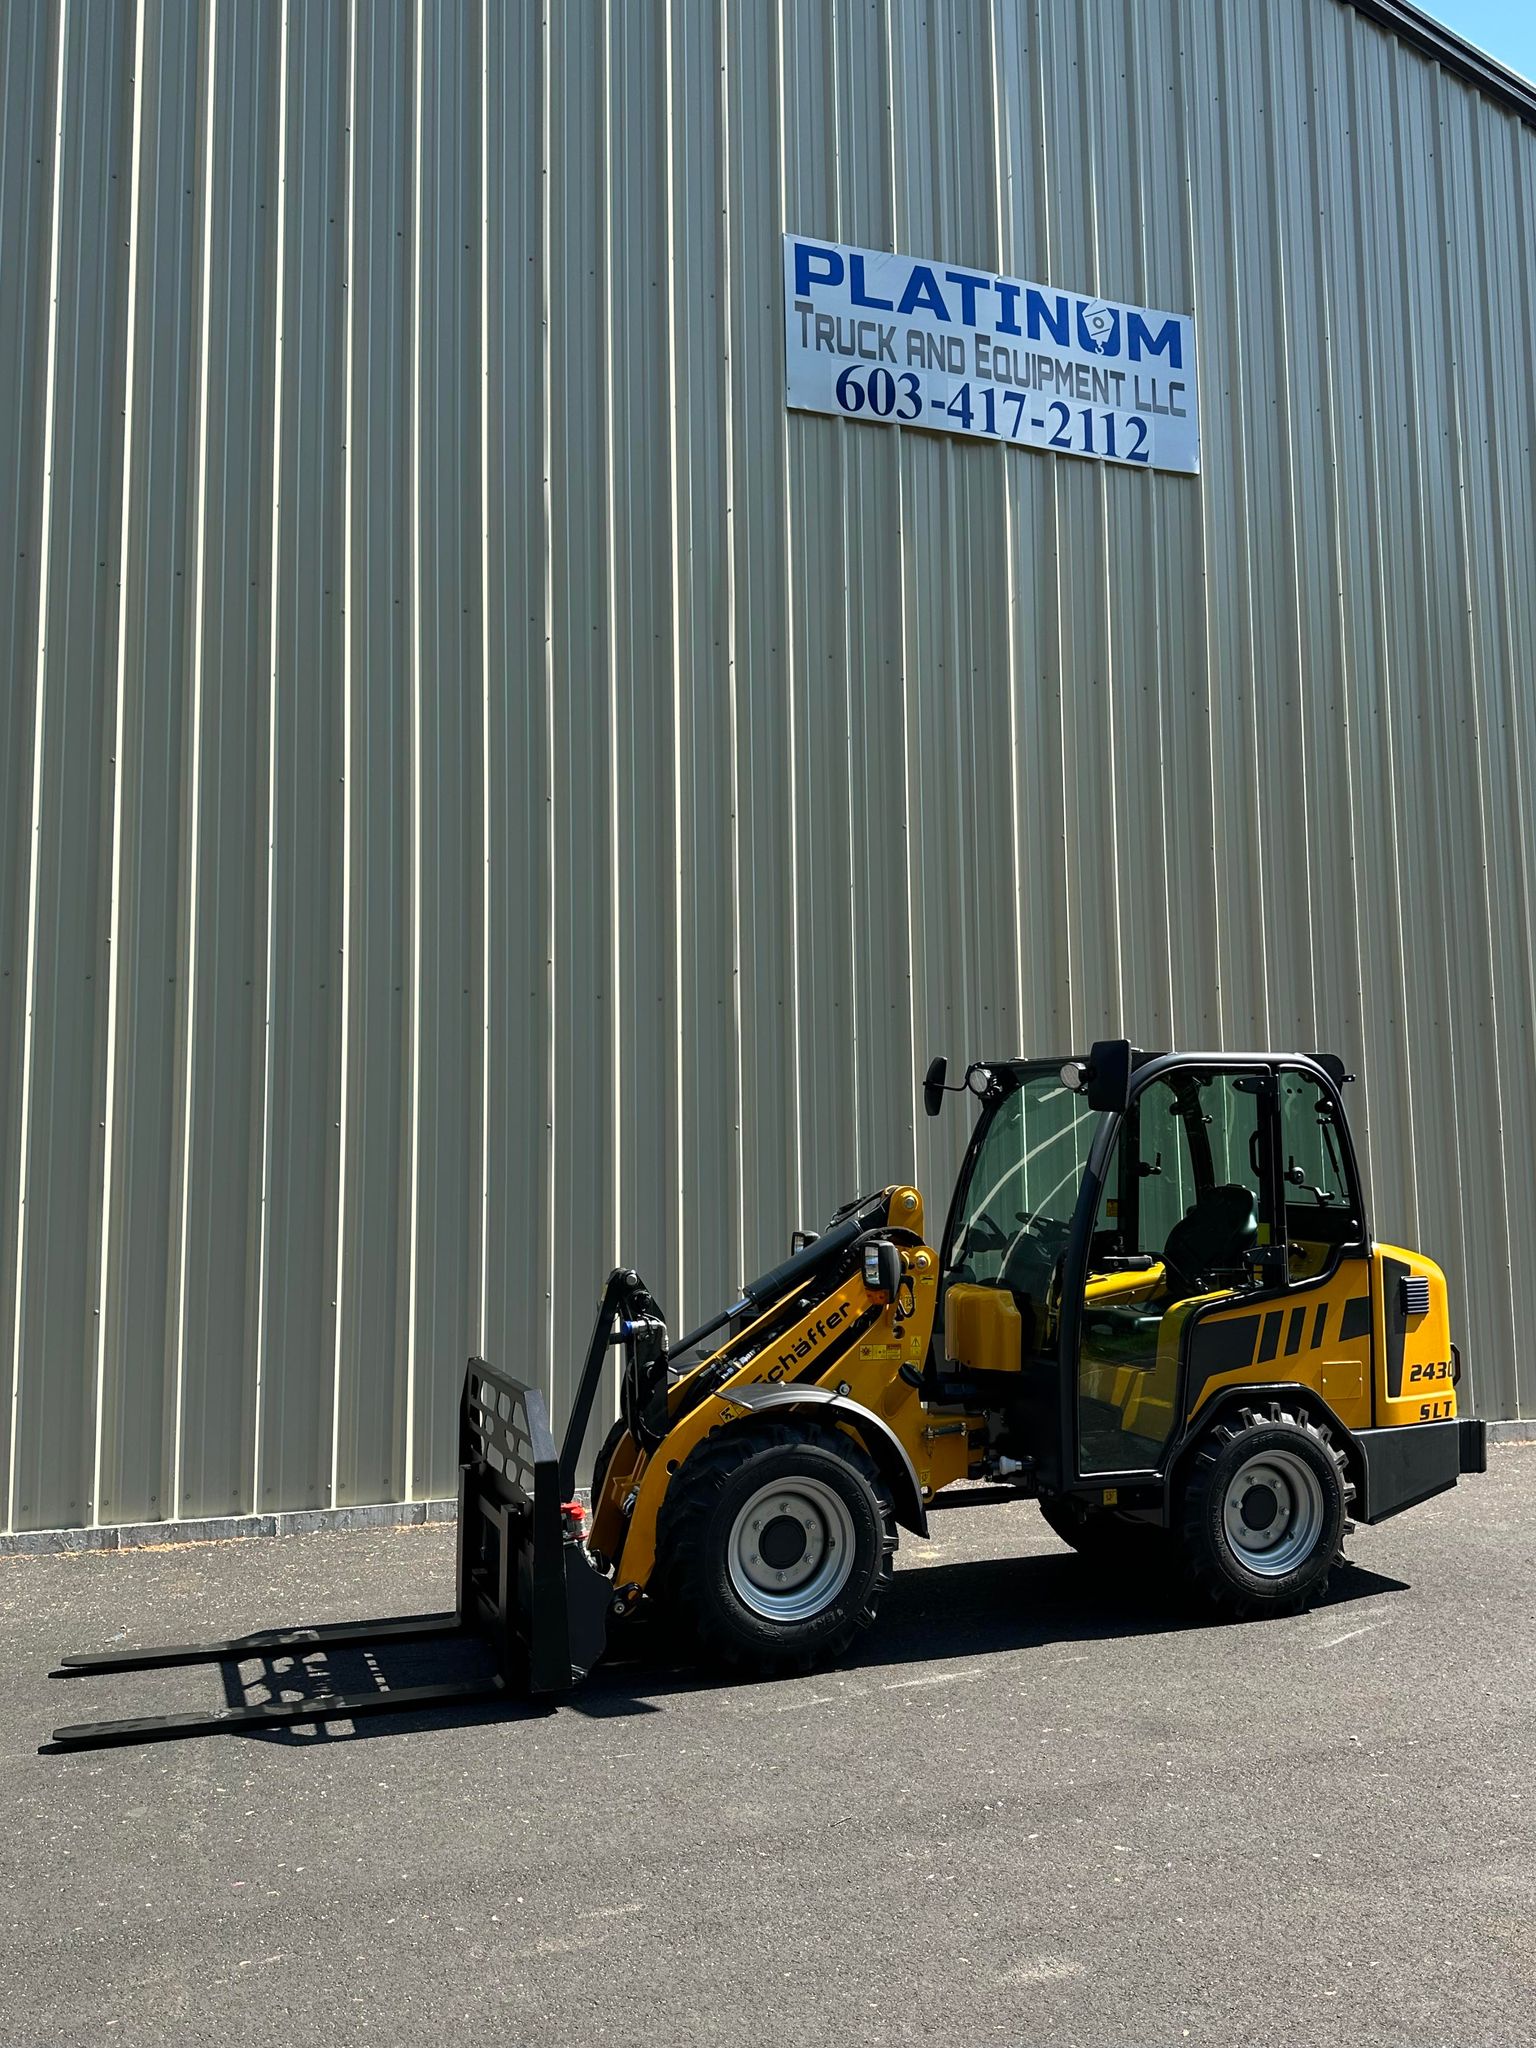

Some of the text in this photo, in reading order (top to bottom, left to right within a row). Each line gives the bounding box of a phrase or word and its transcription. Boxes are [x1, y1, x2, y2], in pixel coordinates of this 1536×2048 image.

[794, 243, 1183, 369] PLATINUM
[794, 301, 1187, 418] TRUCK AND EQUIPMENT LLC
[835, 364, 1150, 463] 603-417-2112
[1420, 1401, 1452, 1420] SLT
